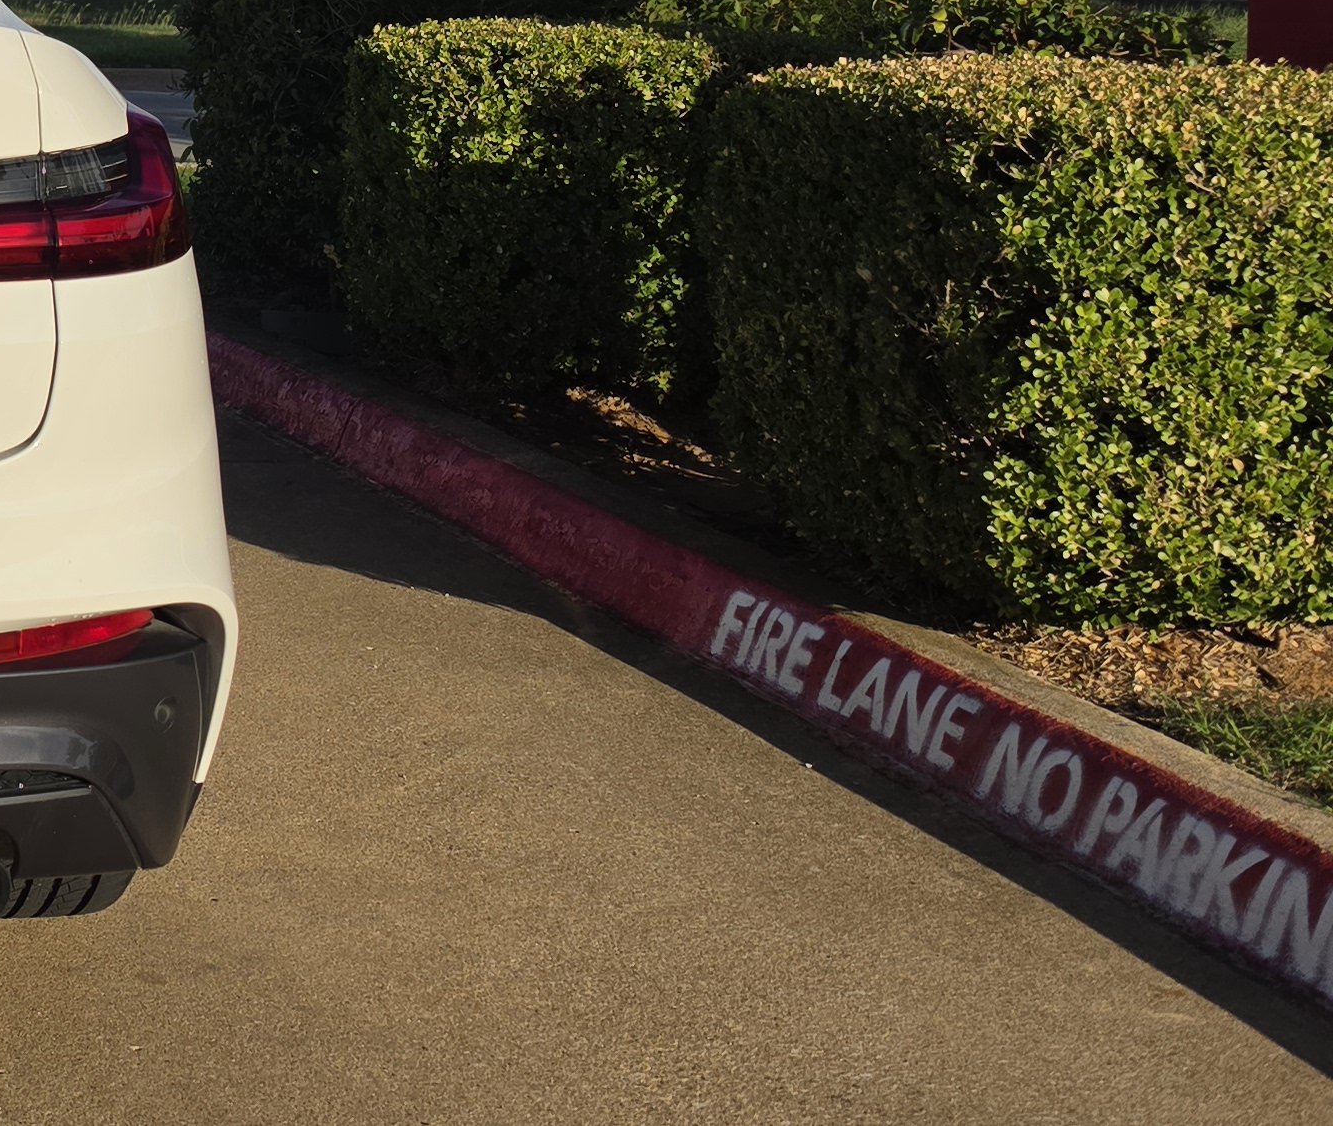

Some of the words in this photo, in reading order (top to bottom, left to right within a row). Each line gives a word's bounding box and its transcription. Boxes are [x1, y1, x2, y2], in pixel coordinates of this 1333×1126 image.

[709, 590, 824, 695] FIRE
[817, 639, 982, 770] LANE
[976, 721, 1084, 836] NO
[1073, 776, 1333, 1000] PARKIN
